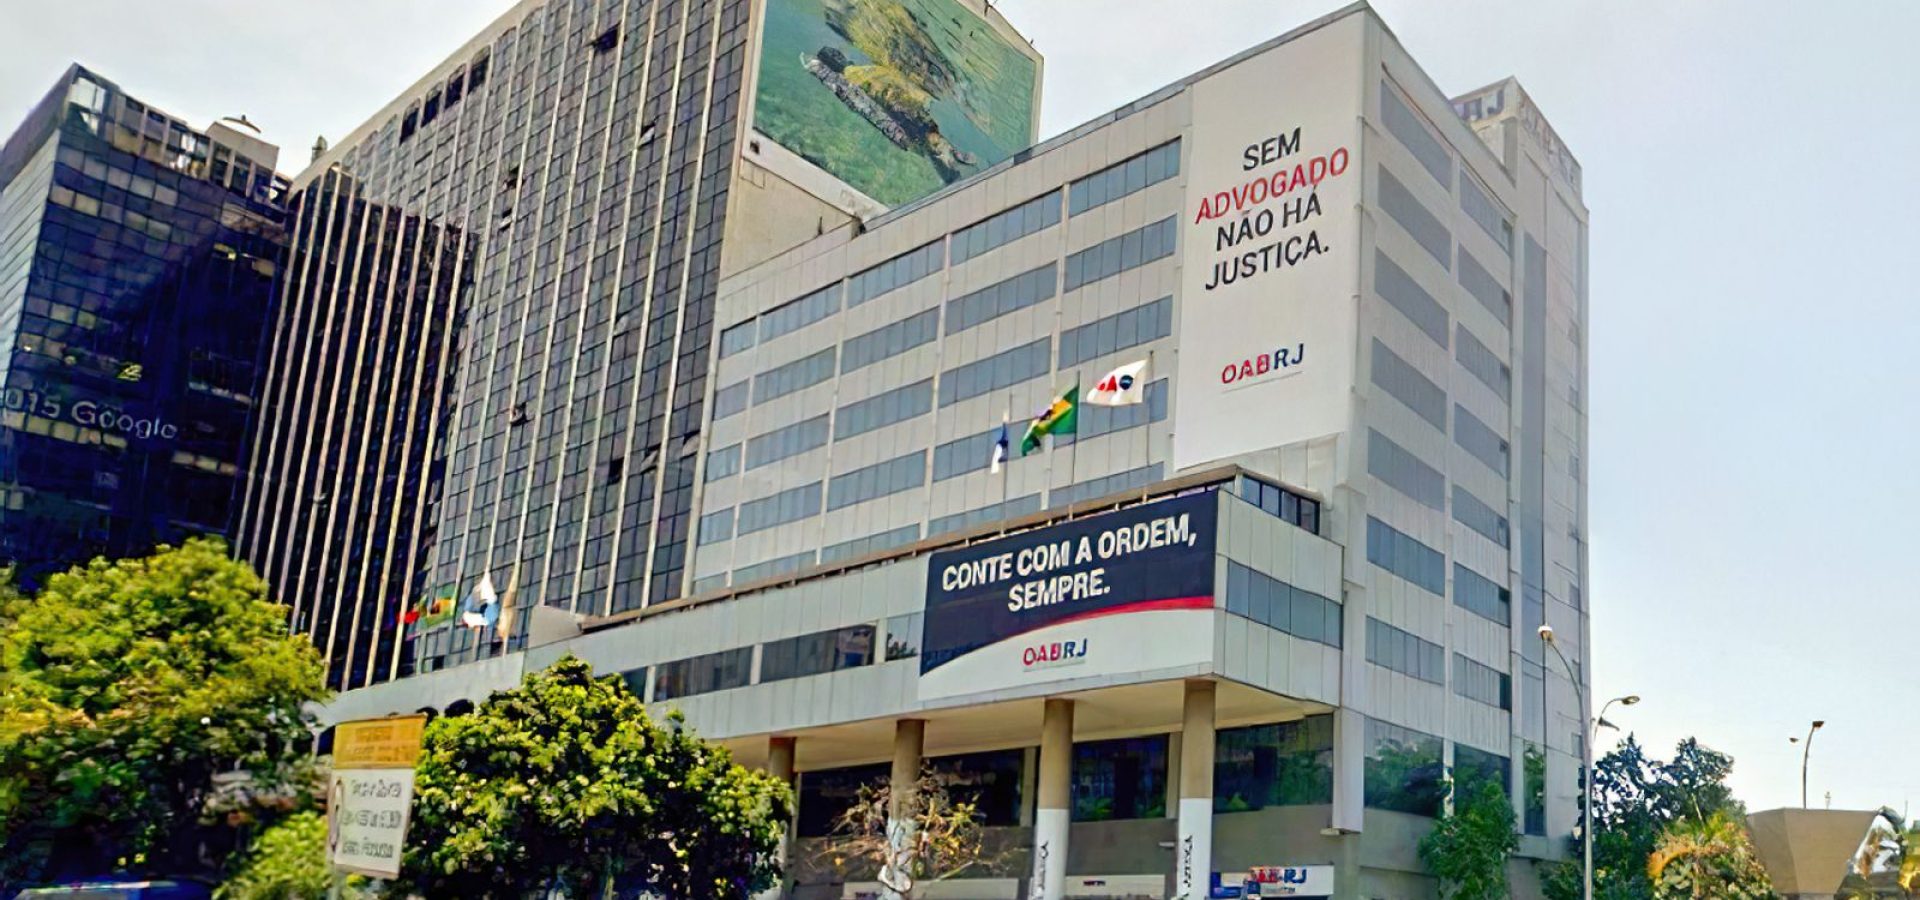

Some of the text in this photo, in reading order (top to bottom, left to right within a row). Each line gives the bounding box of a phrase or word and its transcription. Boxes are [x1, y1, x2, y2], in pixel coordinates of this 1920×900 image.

[1243, 127, 1301, 171] SEM
[1195, 147, 1349, 224] ADVOGADO
[1216, 185, 1322, 251] NÃO HÁ
[1205, 230, 1330, 290] JUSTIÇA.
[1221, 343, 1304, 384] OABRJ
[942, 513, 1197, 591] CONTE COM A ORDEM,
[1008, 568, 1111, 612] SEMPRE.
[1023, 638, 1088, 666] OABRJ
